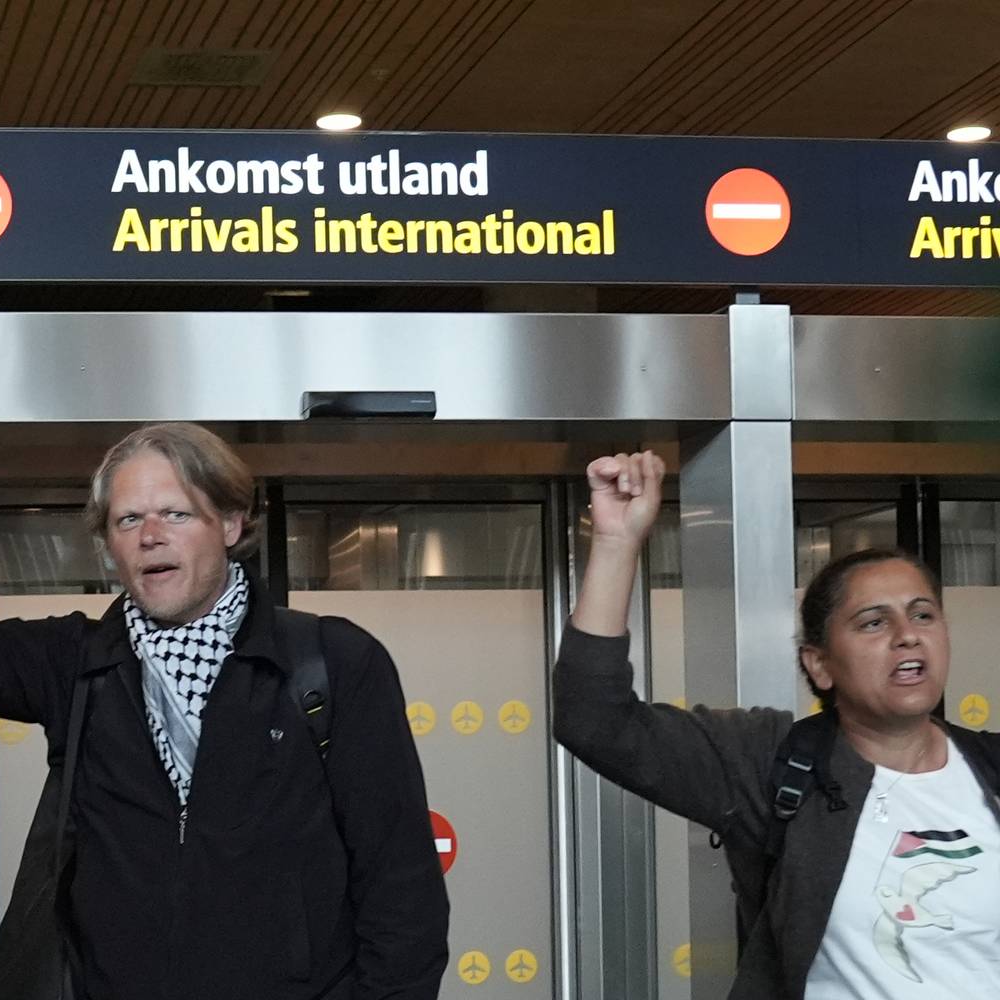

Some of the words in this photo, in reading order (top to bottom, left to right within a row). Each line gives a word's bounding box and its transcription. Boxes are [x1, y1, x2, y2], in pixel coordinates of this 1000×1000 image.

[111, 147, 324, 195] Ankomst
[339, 149, 489, 196] utland
[908, 159, 1000, 203] Ank
[113, 206, 299, 253] Arrivals
[315, 208, 615, 255] international
